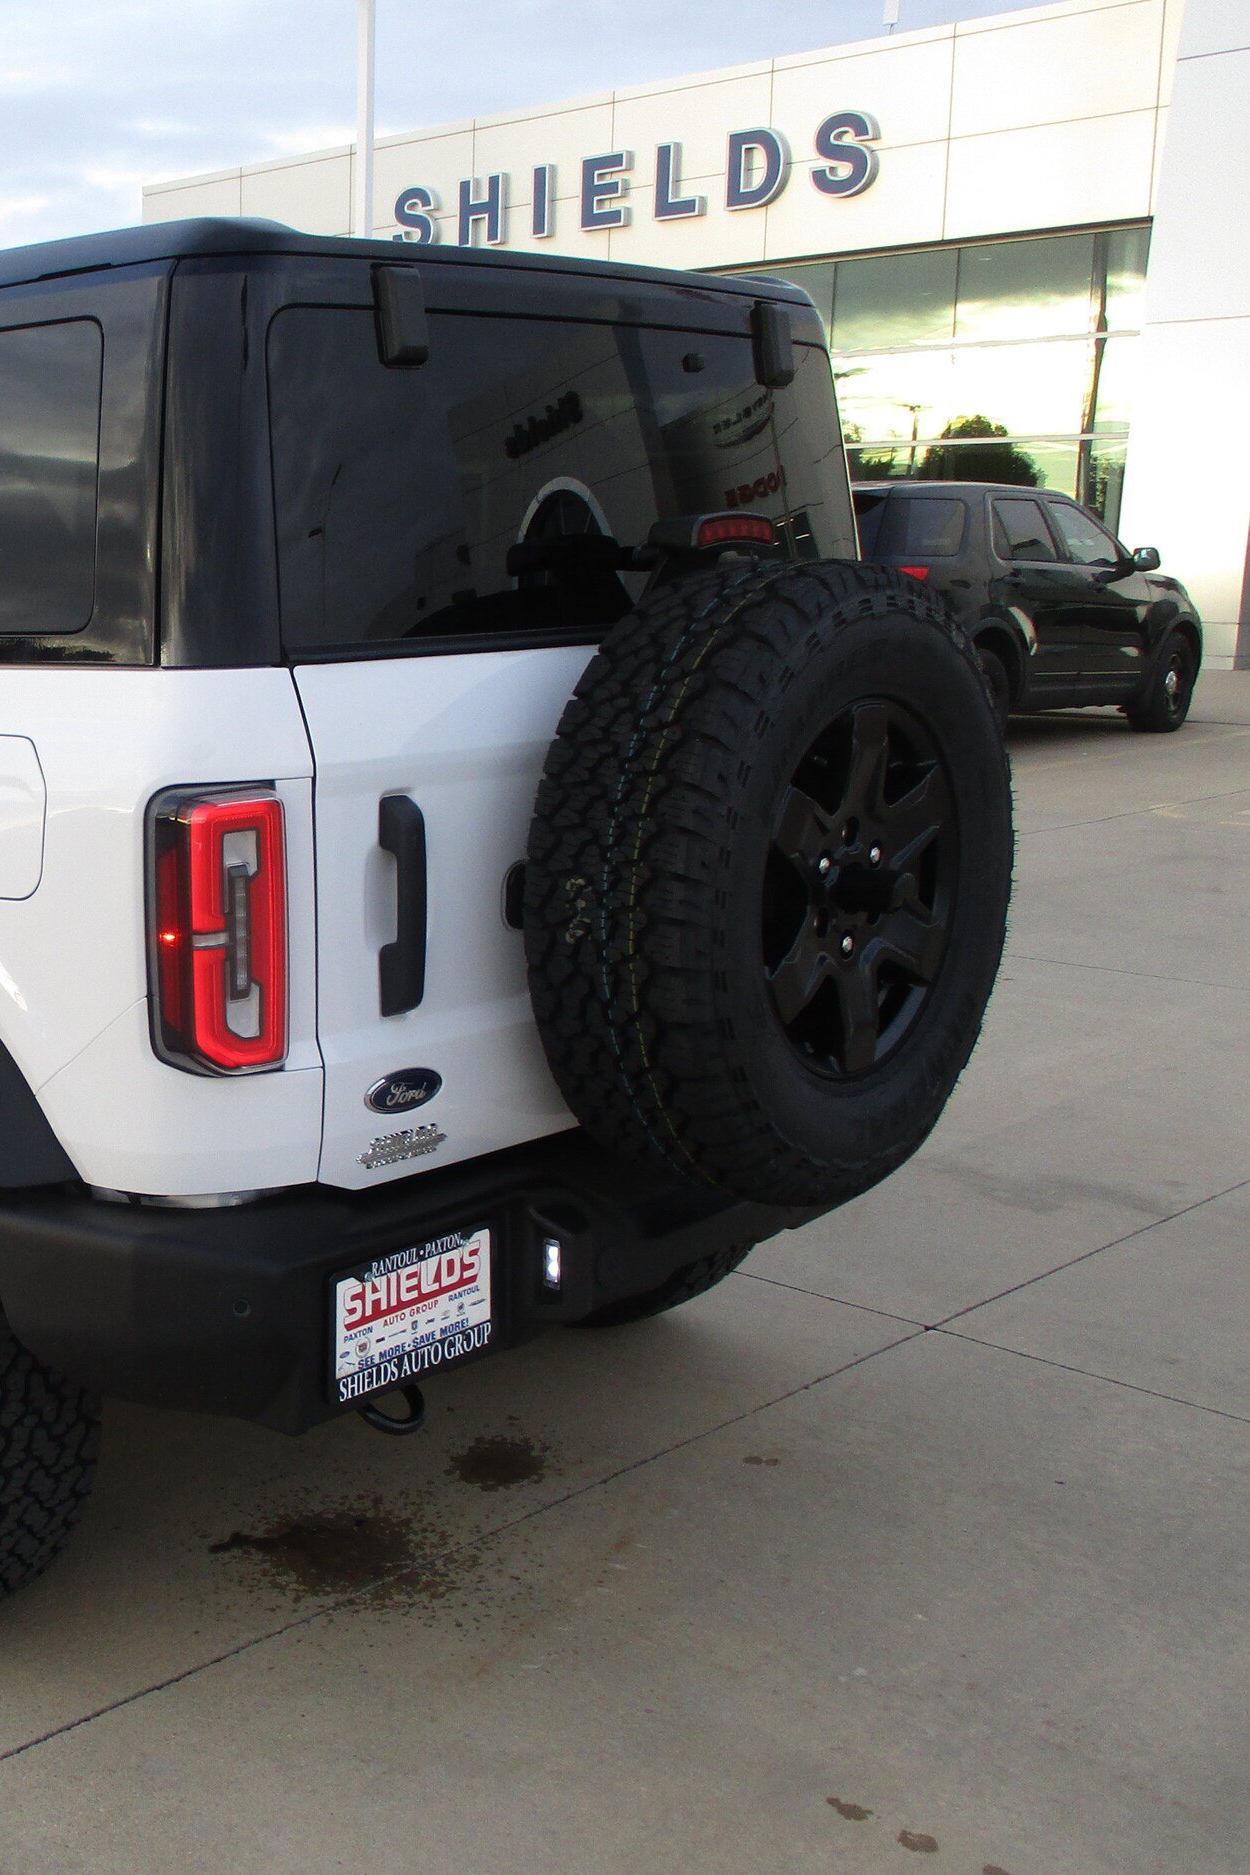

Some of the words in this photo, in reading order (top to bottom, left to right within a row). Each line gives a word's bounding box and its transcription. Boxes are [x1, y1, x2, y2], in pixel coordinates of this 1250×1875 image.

[392, 109, 881, 247] SHIELDS
[386, 1082, 427, 1106] Ford
[371, 1247, 418, 1277] RANTOUL
[424, 1232, 462, 1258] PAXTON
[343, 1239, 481, 1332] SHIELDS
[448, 1286, 480, 1302] RANTOUL
[343, 1326, 374, 1343] PAXTON
[383, 1313, 405, 1328] AUTO
[409, 1300, 439, 1317] GROUP
[339, 1358, 399, 1402] SHIELDS
[400, 1345, 442, 1378] AUTO
[444, 1322, 492, 1360] GROUP
[357, 1356, 376, 1370] SEE
[440, 1317, 469, 1337] MORE!
